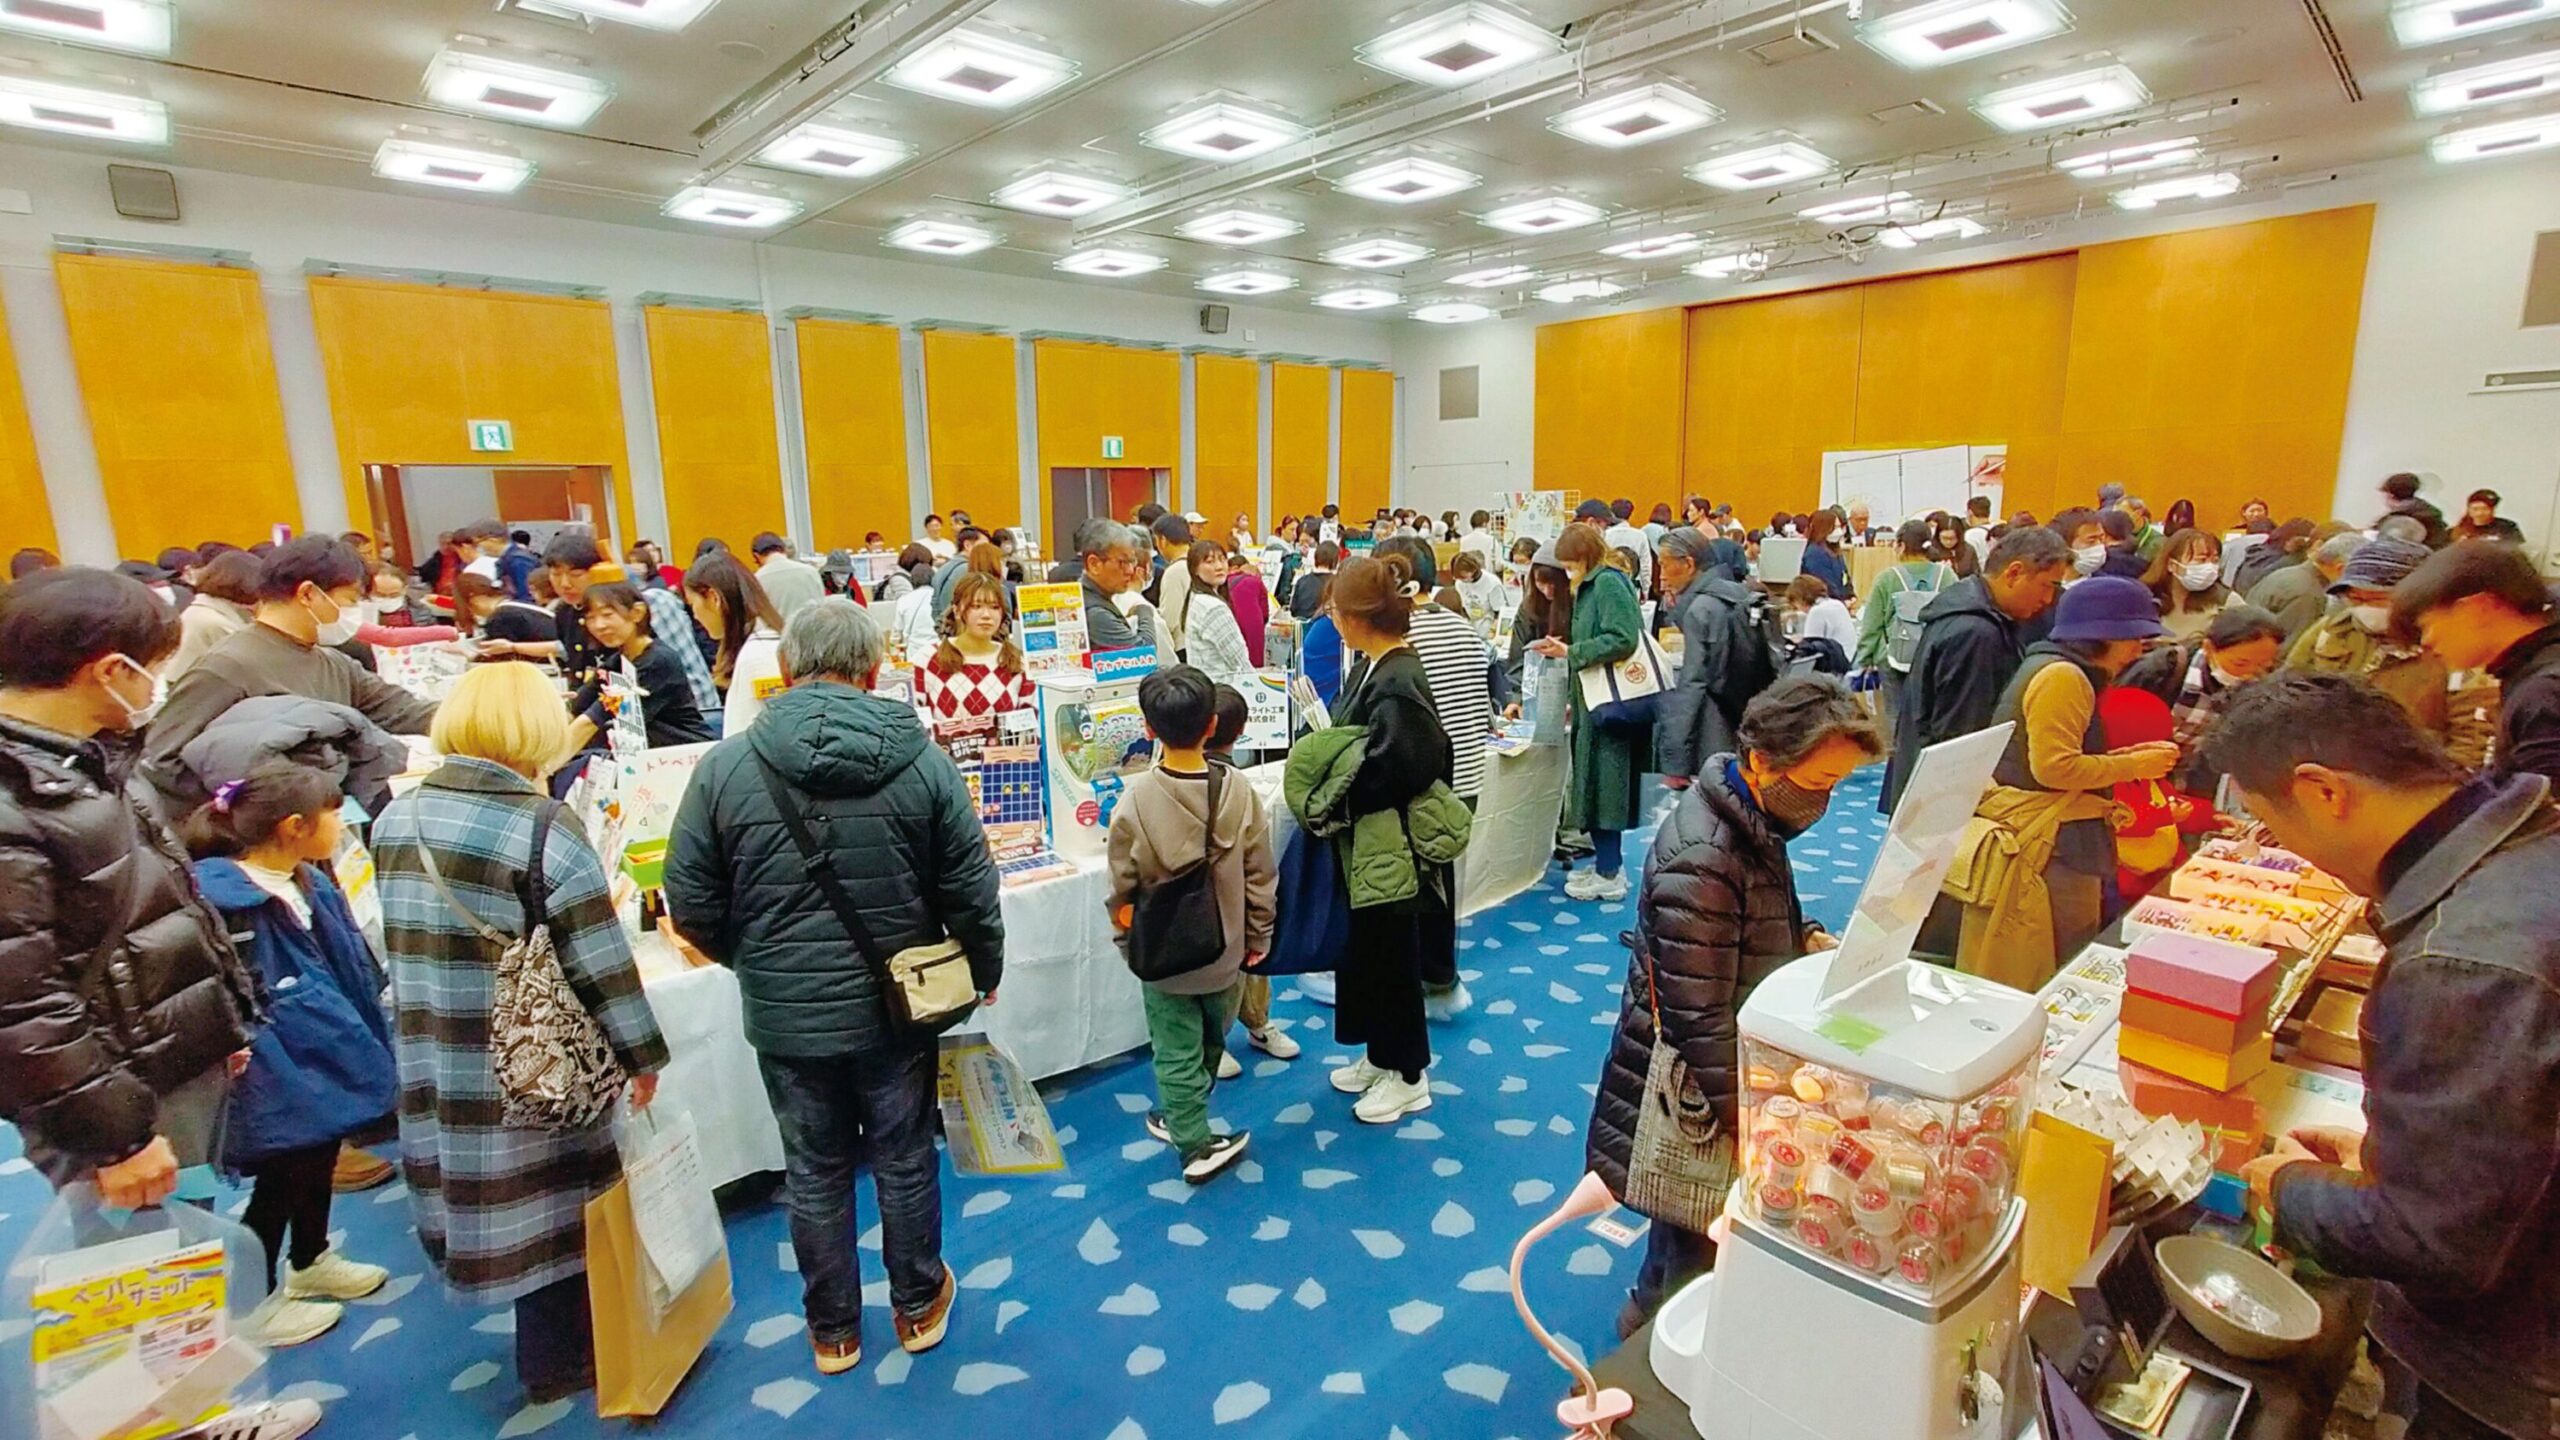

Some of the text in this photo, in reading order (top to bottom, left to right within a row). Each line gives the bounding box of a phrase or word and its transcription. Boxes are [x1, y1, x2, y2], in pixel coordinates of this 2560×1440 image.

[1096, 655, 1156, 673] 空カプセル入れ
[1248, 706, 1285, 714] ライト工業
